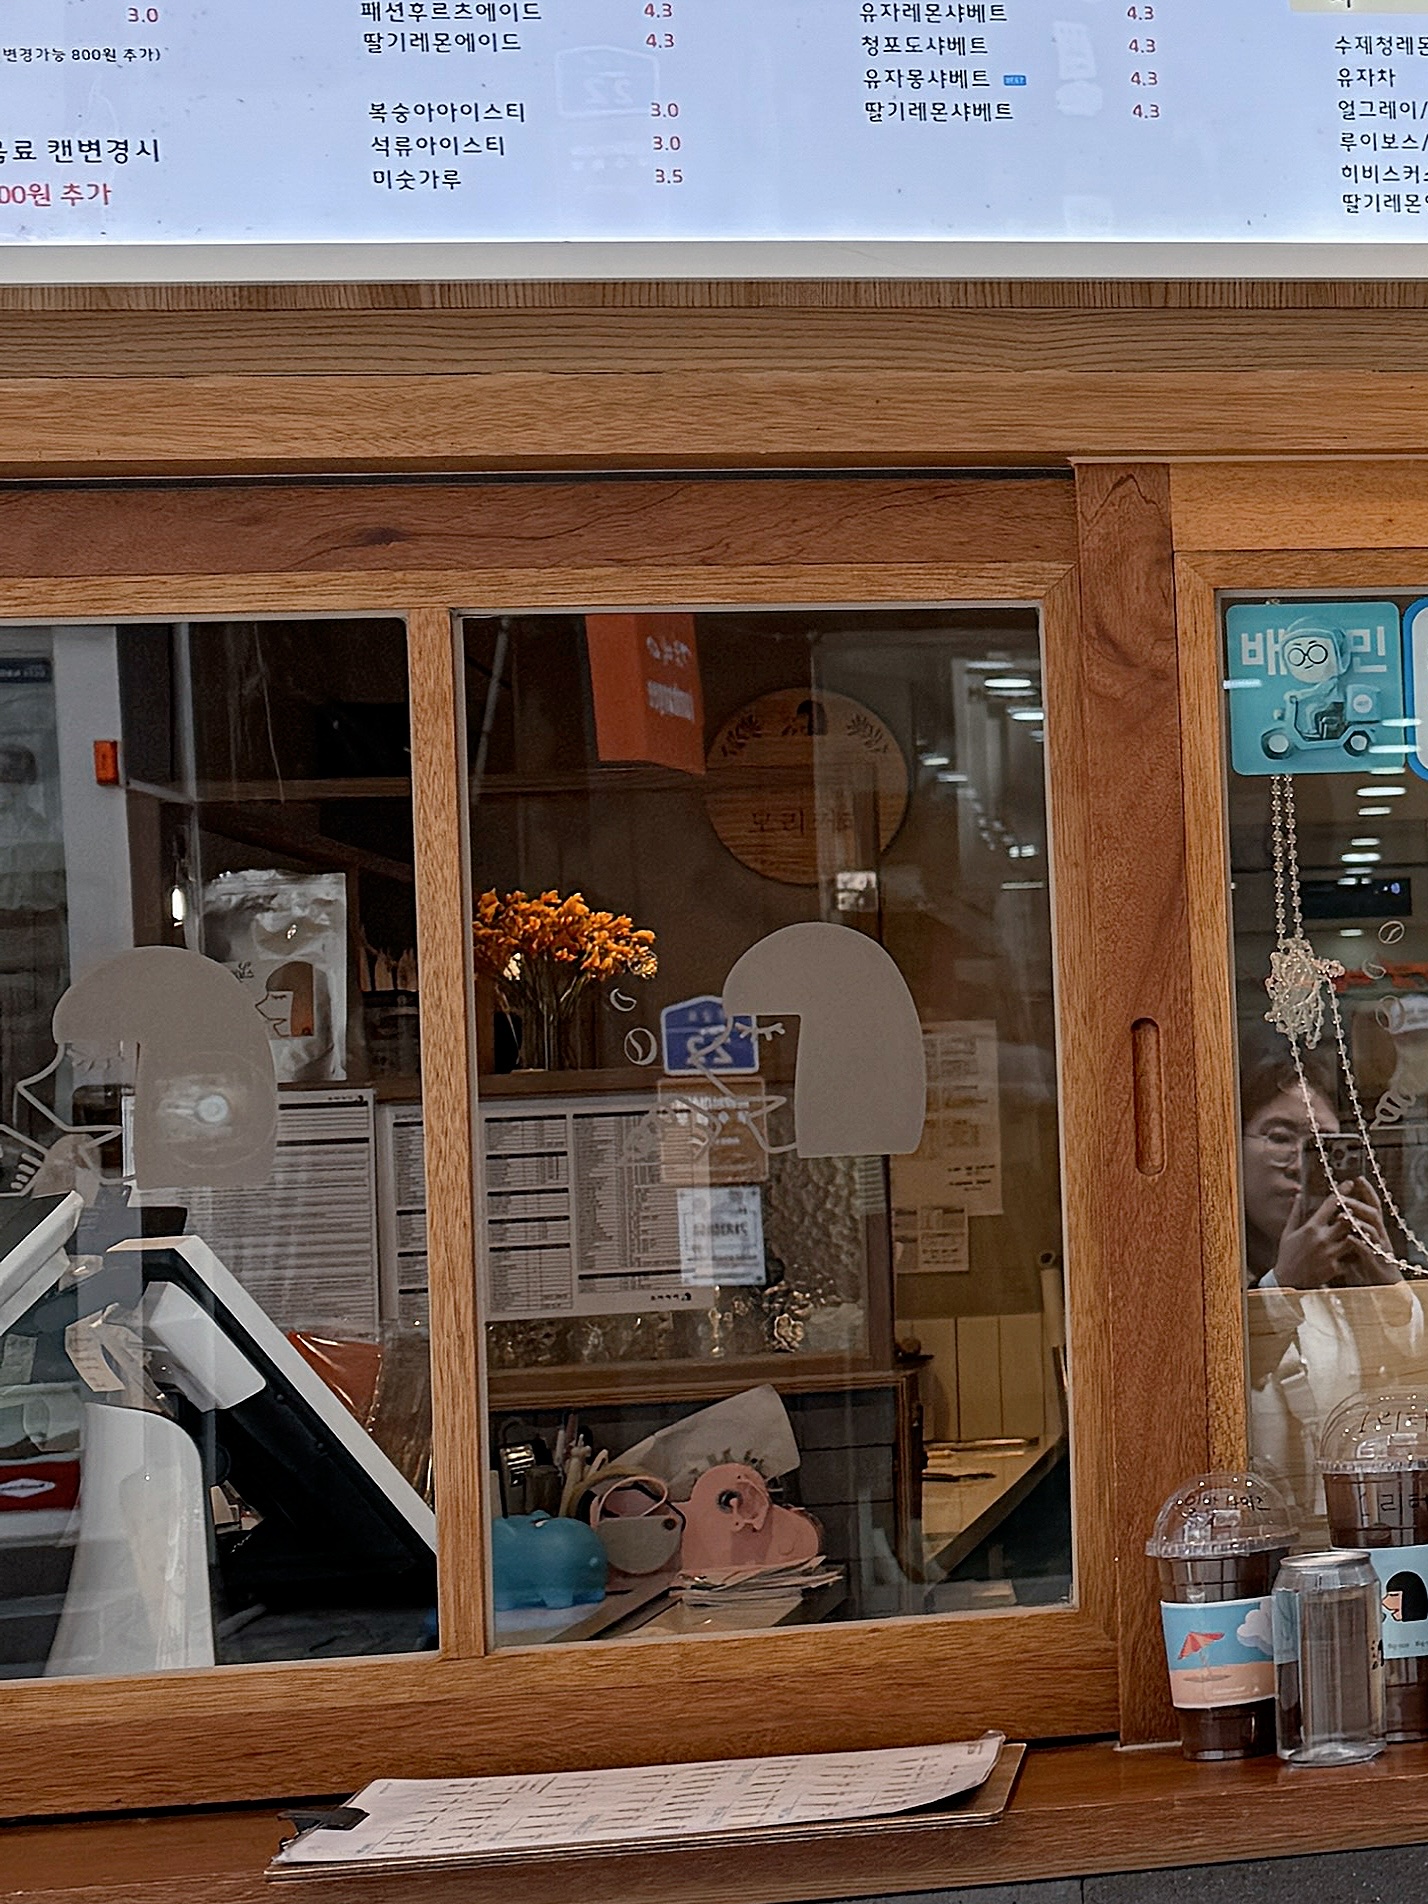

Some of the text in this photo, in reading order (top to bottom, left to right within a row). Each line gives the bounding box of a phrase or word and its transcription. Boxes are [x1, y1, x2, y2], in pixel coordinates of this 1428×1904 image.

[128, 8, 158, 22] 3.0
[361, 2, 672, 22] 패션후르츠에이드 4.3
[860, 3, 1154, 23] 유자레몬샤베트 4.3
[364, 33, 674, 53] 딸기레몬에이드 4.3
[862, 36, 1155, 56] 청포도샤베트 4.3
[3, 48, 160, 62] 변경가능 800원 추가)
[863, 69, 990, 89] 유자몽샤베트
[1131, 72, 1157, 86] 4.3
[1337, 68, 1396, 87] 유자차
[369, 102, 678, 123] 복숭아아이스티 3.0
[865, 102, 1159, 122] 딸기레몬샤베트 4.3
[48, 139, 159, 164] 캔변경시
[372, 136, 680, 157] 석류아이스티 3.0
[373, 169, 683, 190] 미숫가루 3.5
[61, 183, 112, 206] 추가
